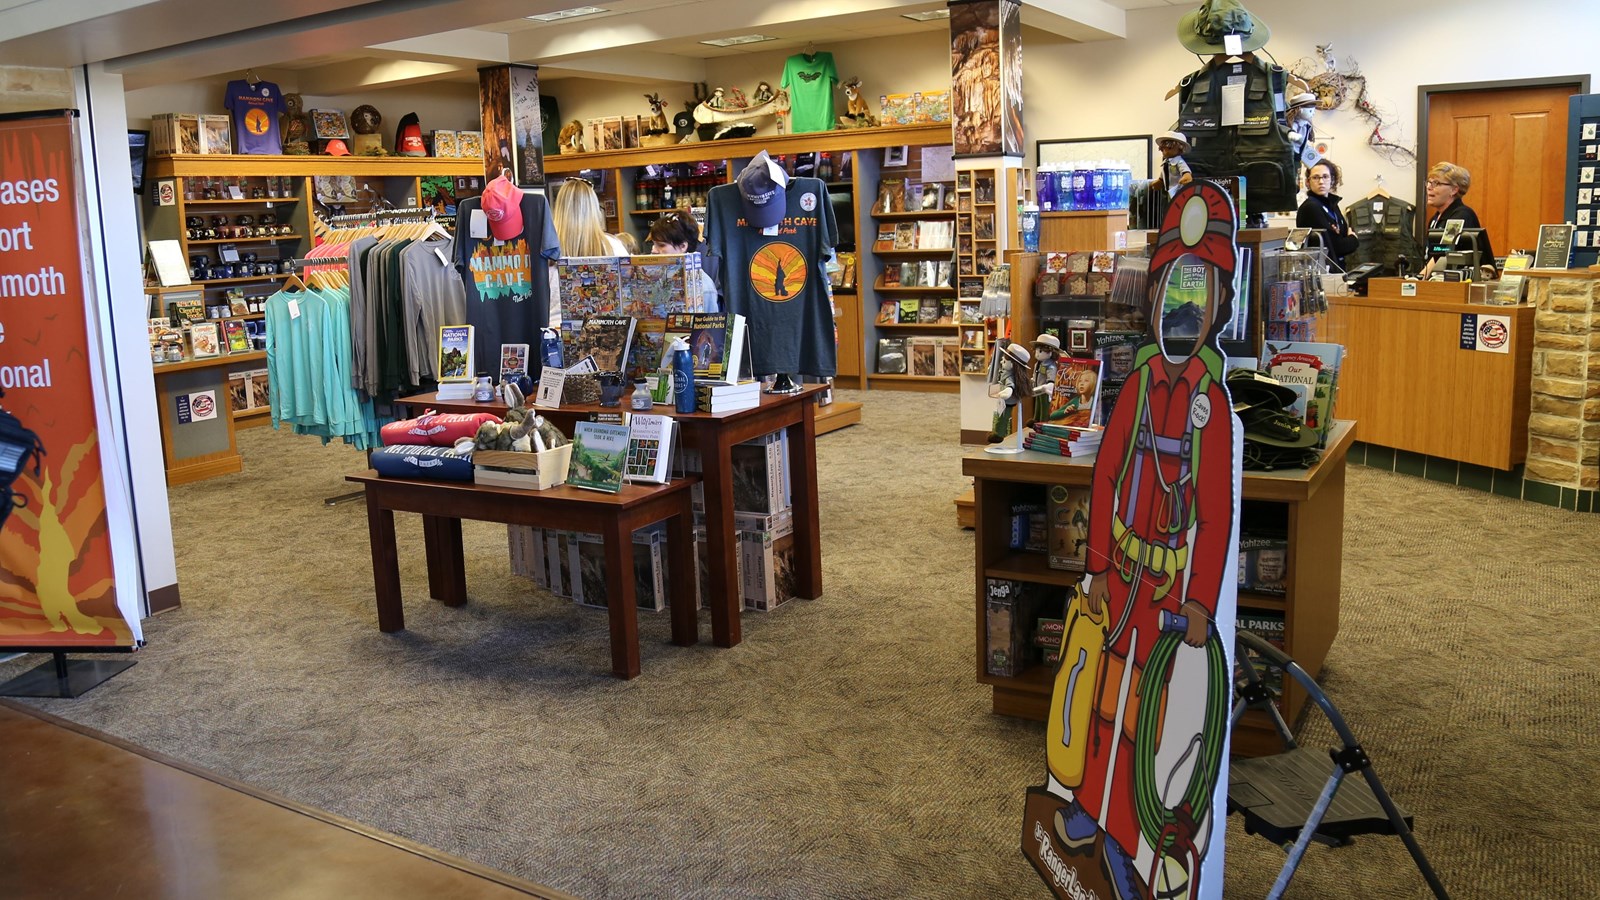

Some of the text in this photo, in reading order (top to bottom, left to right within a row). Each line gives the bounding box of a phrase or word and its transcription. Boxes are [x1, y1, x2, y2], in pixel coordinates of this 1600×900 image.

[794, 217, 817, 227] CAVE
[0, 266, 66, 297] moth
[1097, 335, 1125, 345] Yahtzee
[1273, 374, 1314, 385] NATIONAL
[1239, 539, 1271, 549] Yahtzee
[990, 585, 1010, 597] Jenga
[1248, 621, 1285, 631] PARKS
